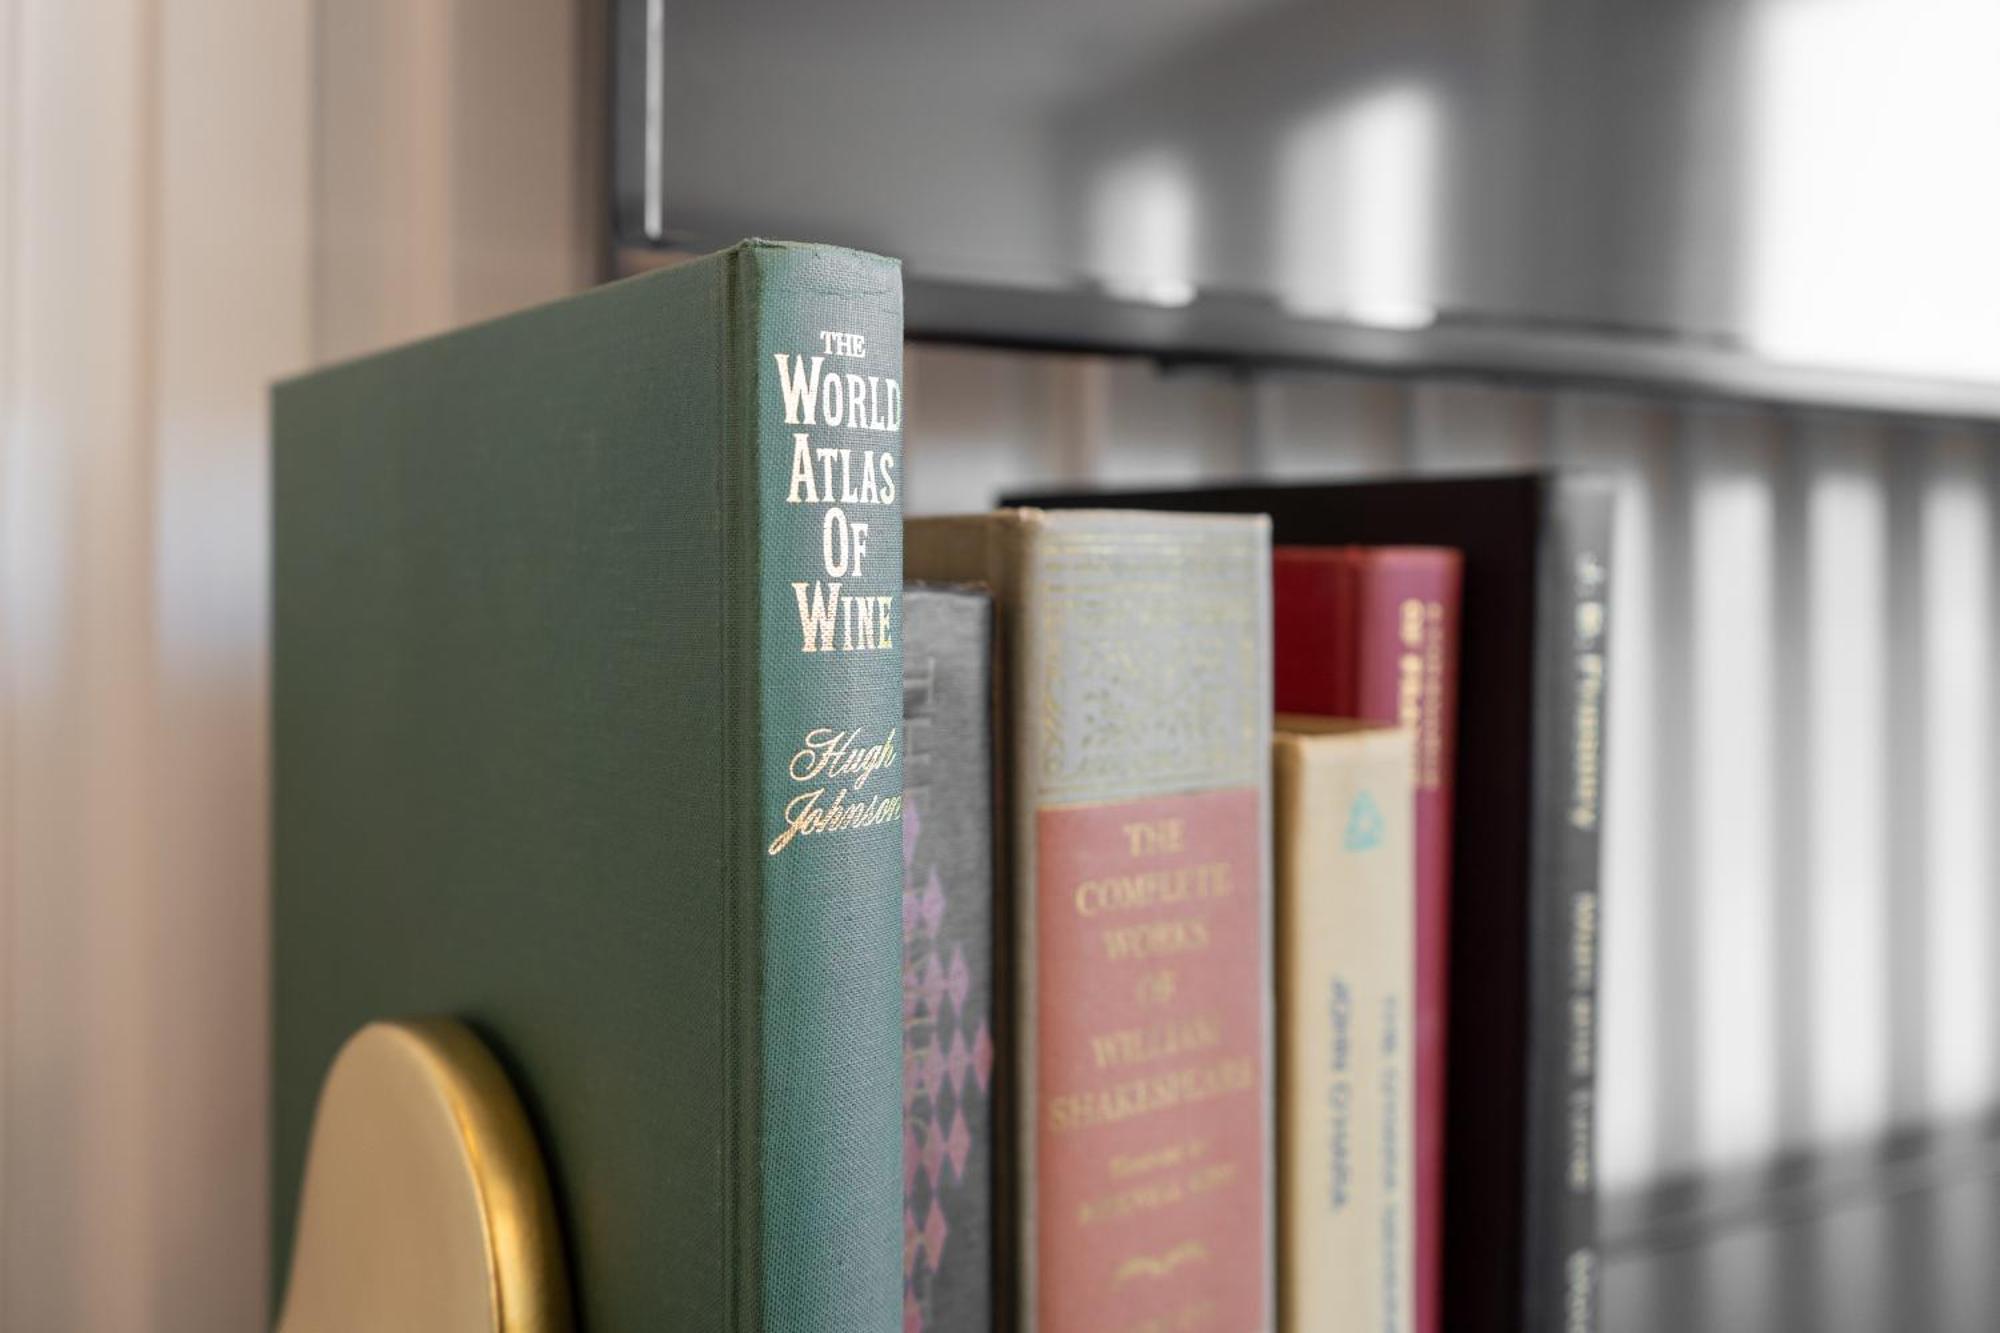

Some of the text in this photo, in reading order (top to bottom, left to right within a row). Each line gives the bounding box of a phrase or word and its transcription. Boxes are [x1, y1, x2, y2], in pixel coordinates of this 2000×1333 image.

[820, 331, 866, 358] THE
[774, 354, 902, 432] WORLD
[786, 433, 896, 505] ATLAS
[823, 507, 869, 578] OF
[791, 579, 893, 653] WINE
[789, 721, 897, 790] Hugh
[768, 787, 902, 856] Johnson
[1122, 816, 1187, 858] THE
[1073, 862, 1233, 919] COMPLETE
